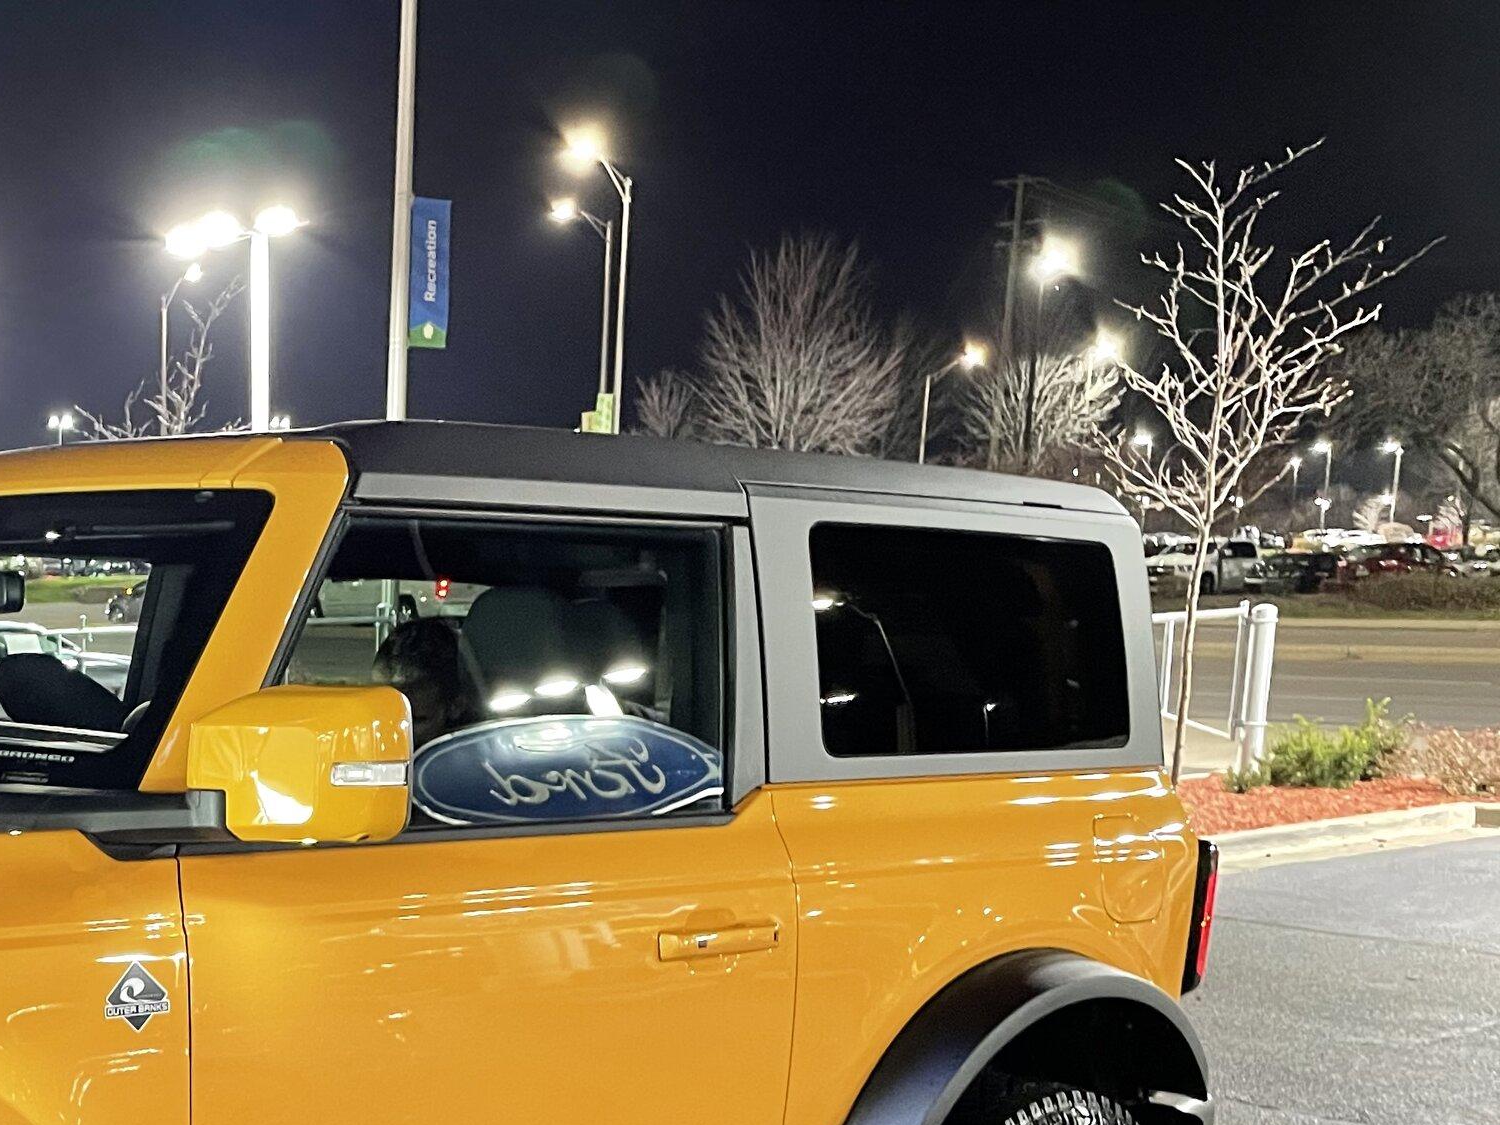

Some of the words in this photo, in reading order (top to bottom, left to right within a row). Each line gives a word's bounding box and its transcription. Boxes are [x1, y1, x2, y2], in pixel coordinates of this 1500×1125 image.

[423, 220, 437, 302] Recreation
[107, 1004, 137, 1016] OUTER
[138, 1002, 168, 1013] BANKS
